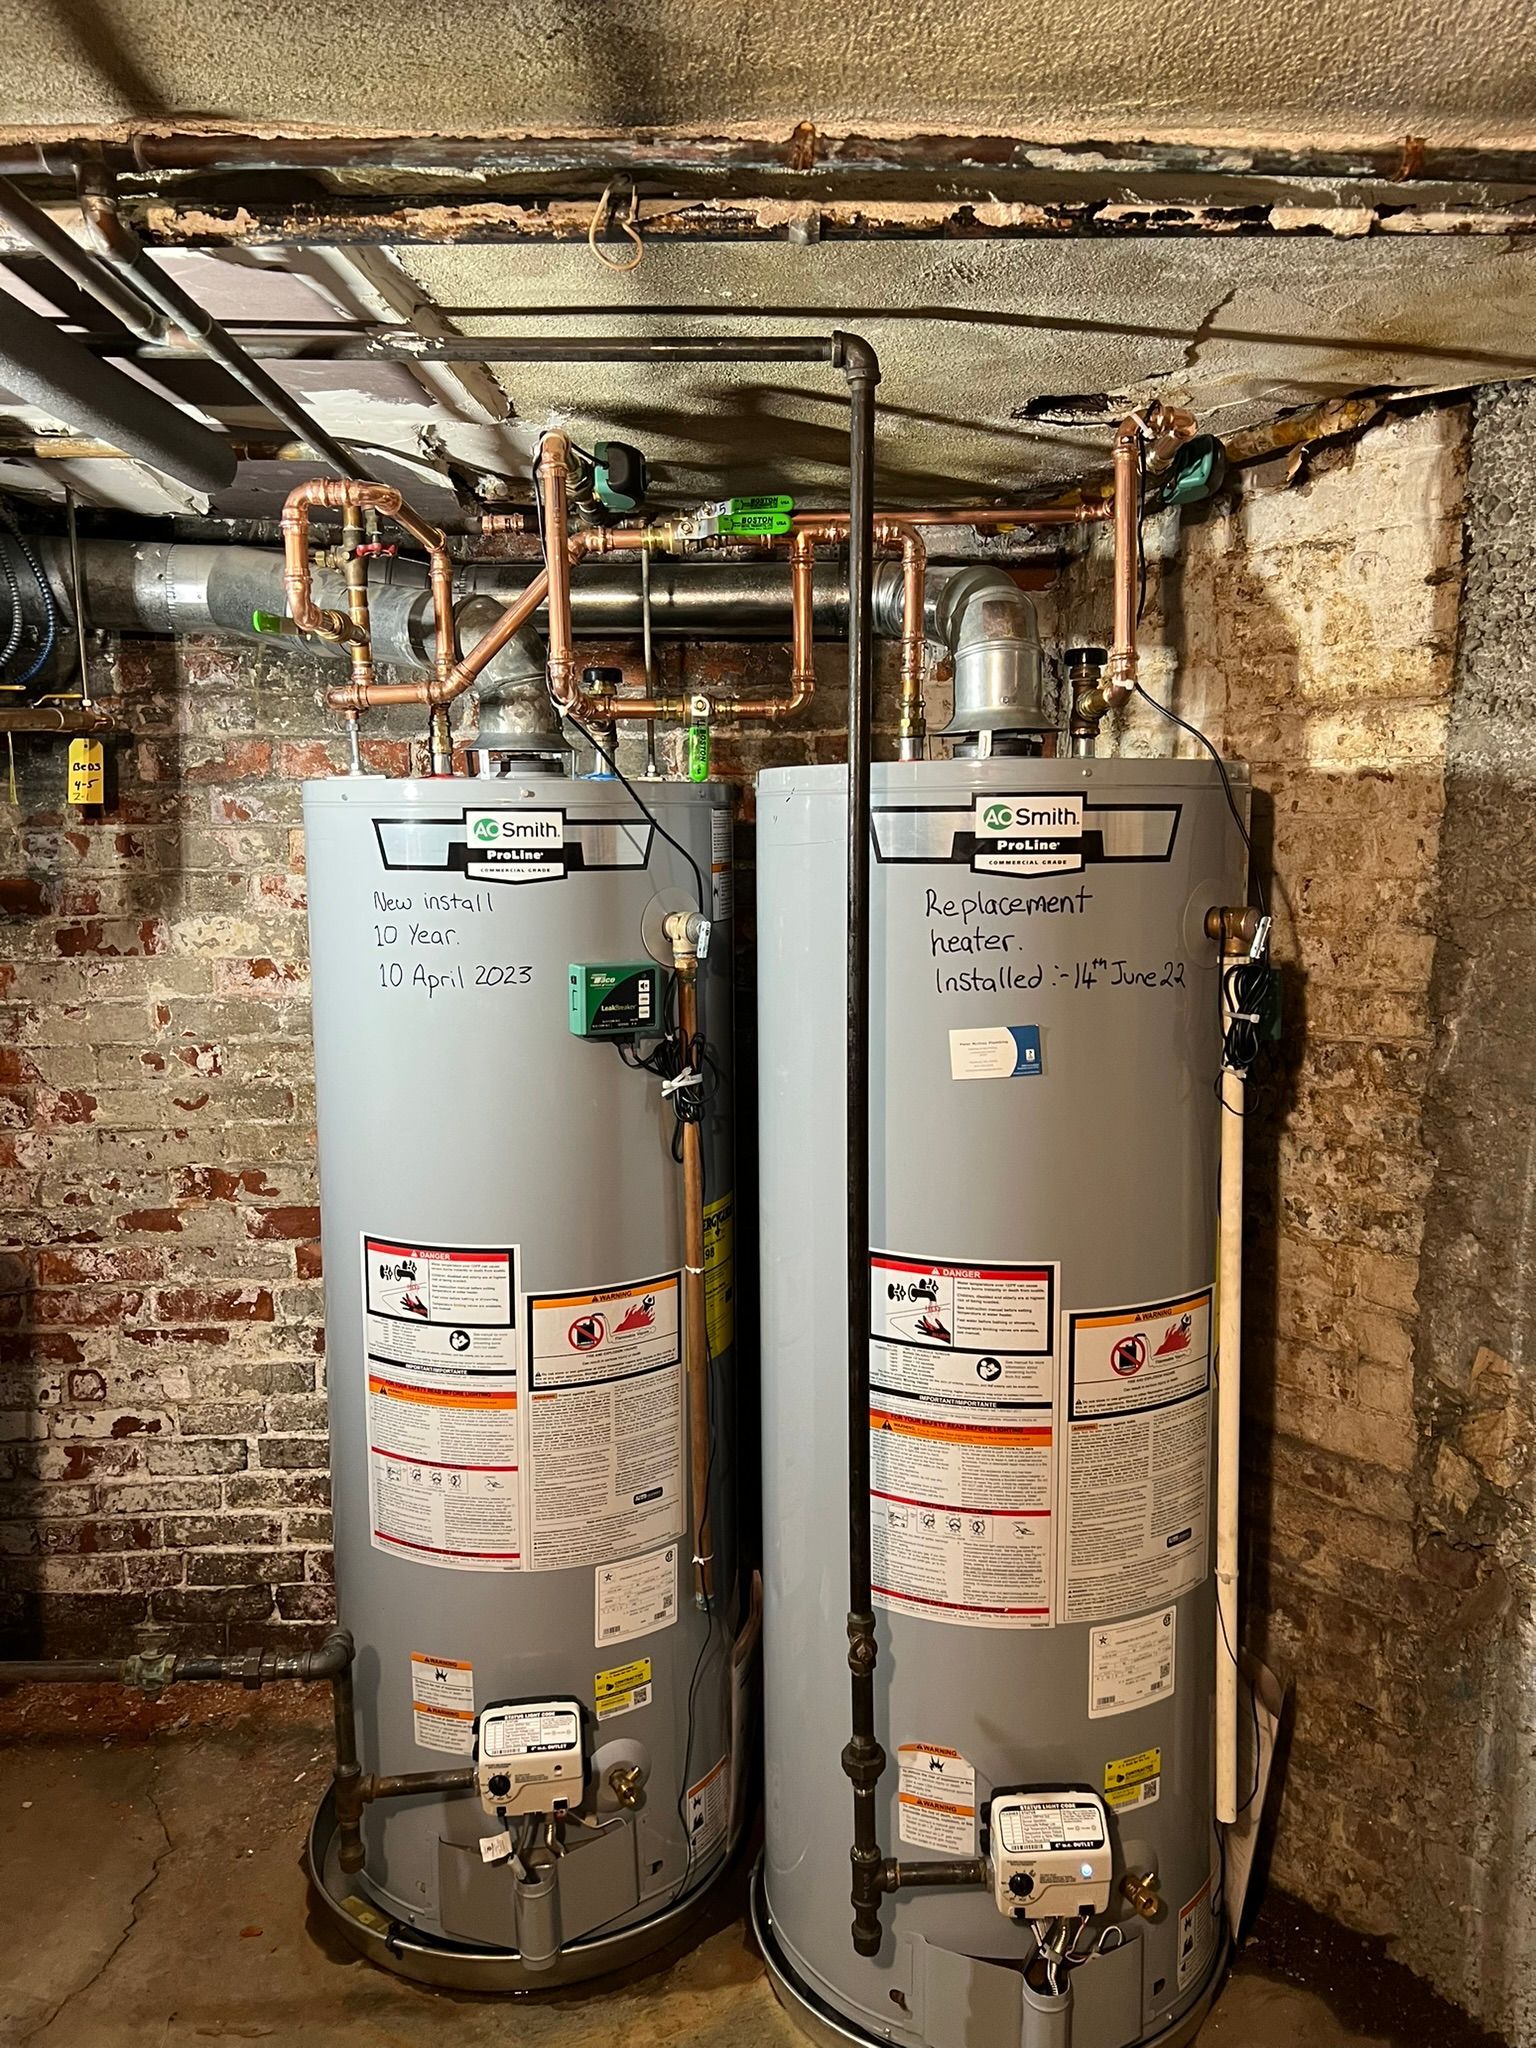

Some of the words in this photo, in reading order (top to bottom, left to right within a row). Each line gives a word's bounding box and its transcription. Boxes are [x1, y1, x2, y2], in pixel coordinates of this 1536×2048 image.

[720, 503, 726, 515] 5
[996, 840, 1058, 850] ProLine
[487, 850, 541, 860] ProLine
[374, 891, 412, 912] New
[424, 892, 494, 912] install
[925, 885, 1093, 924] Replacement
[375, 924, 398, 947] 10
[409, 924, 460, 946] Year.
[930, 926, 1023, 957] heater.
[380, 962, 402, 988] 10
[412, 965, 464, 998] April
[475, 964, 533, 986] 2023
[936, 964, 1042, 994] Installed
[1111, 960, 1156, 987] June
[420, 1250, 450, 1260] DANGER
[942, 1269, 980, 1278] DANGER
[600, 1290, 632, 1301] WARNING
[1142, 1308, 1172, 1320] WARNING
[919, 1395, 997, 1408] IMPORTANT/IMPORTANTE
[430, 1659, 457, 1667] WARNING
[432, 1708, 460, 1717] WARNING
[923, 1745, 957, 1756] WARNING
[922, 1801, 957, 1812] WARNING
